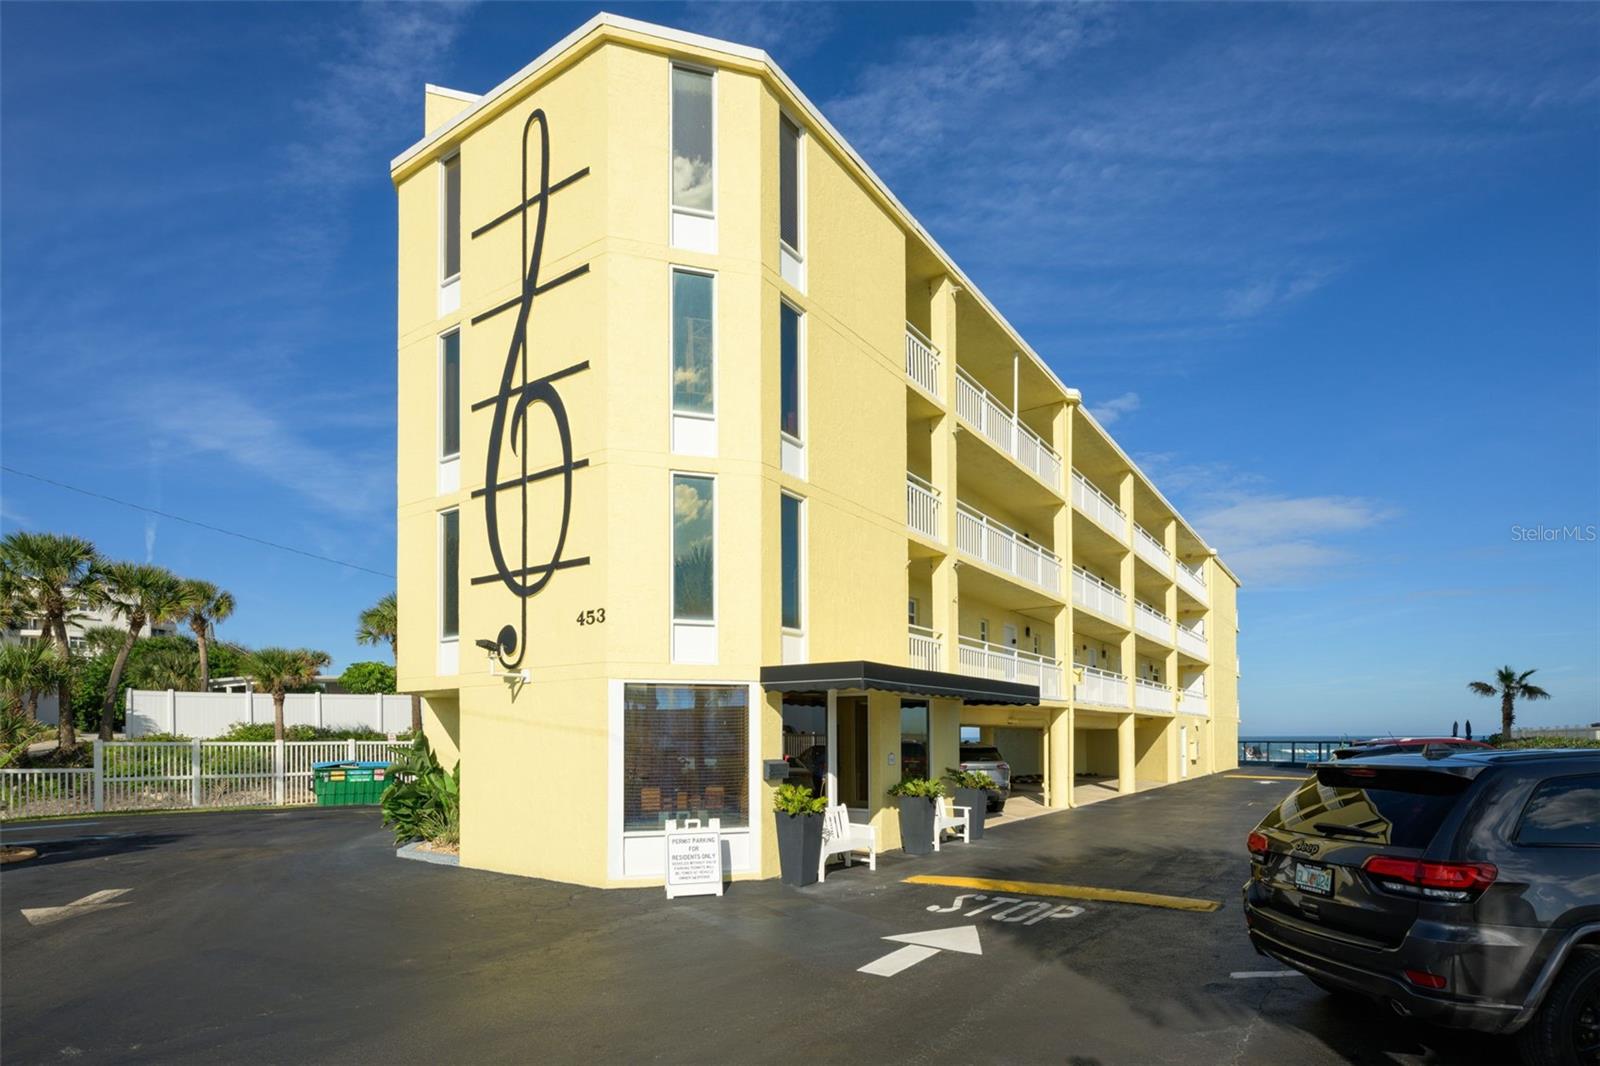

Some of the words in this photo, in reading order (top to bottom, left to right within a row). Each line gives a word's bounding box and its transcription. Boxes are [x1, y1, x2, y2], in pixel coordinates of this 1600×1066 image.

[576, 607, 606, 626] 453
[692, 836, 716, 844] PARKING
[1295, 840, 1320, 856] Jeep
[671, 853, 701, 861] RESIDENTS
[701, 852, 716, 860] ONLY
[926, 893, 1086, 926] STOP
